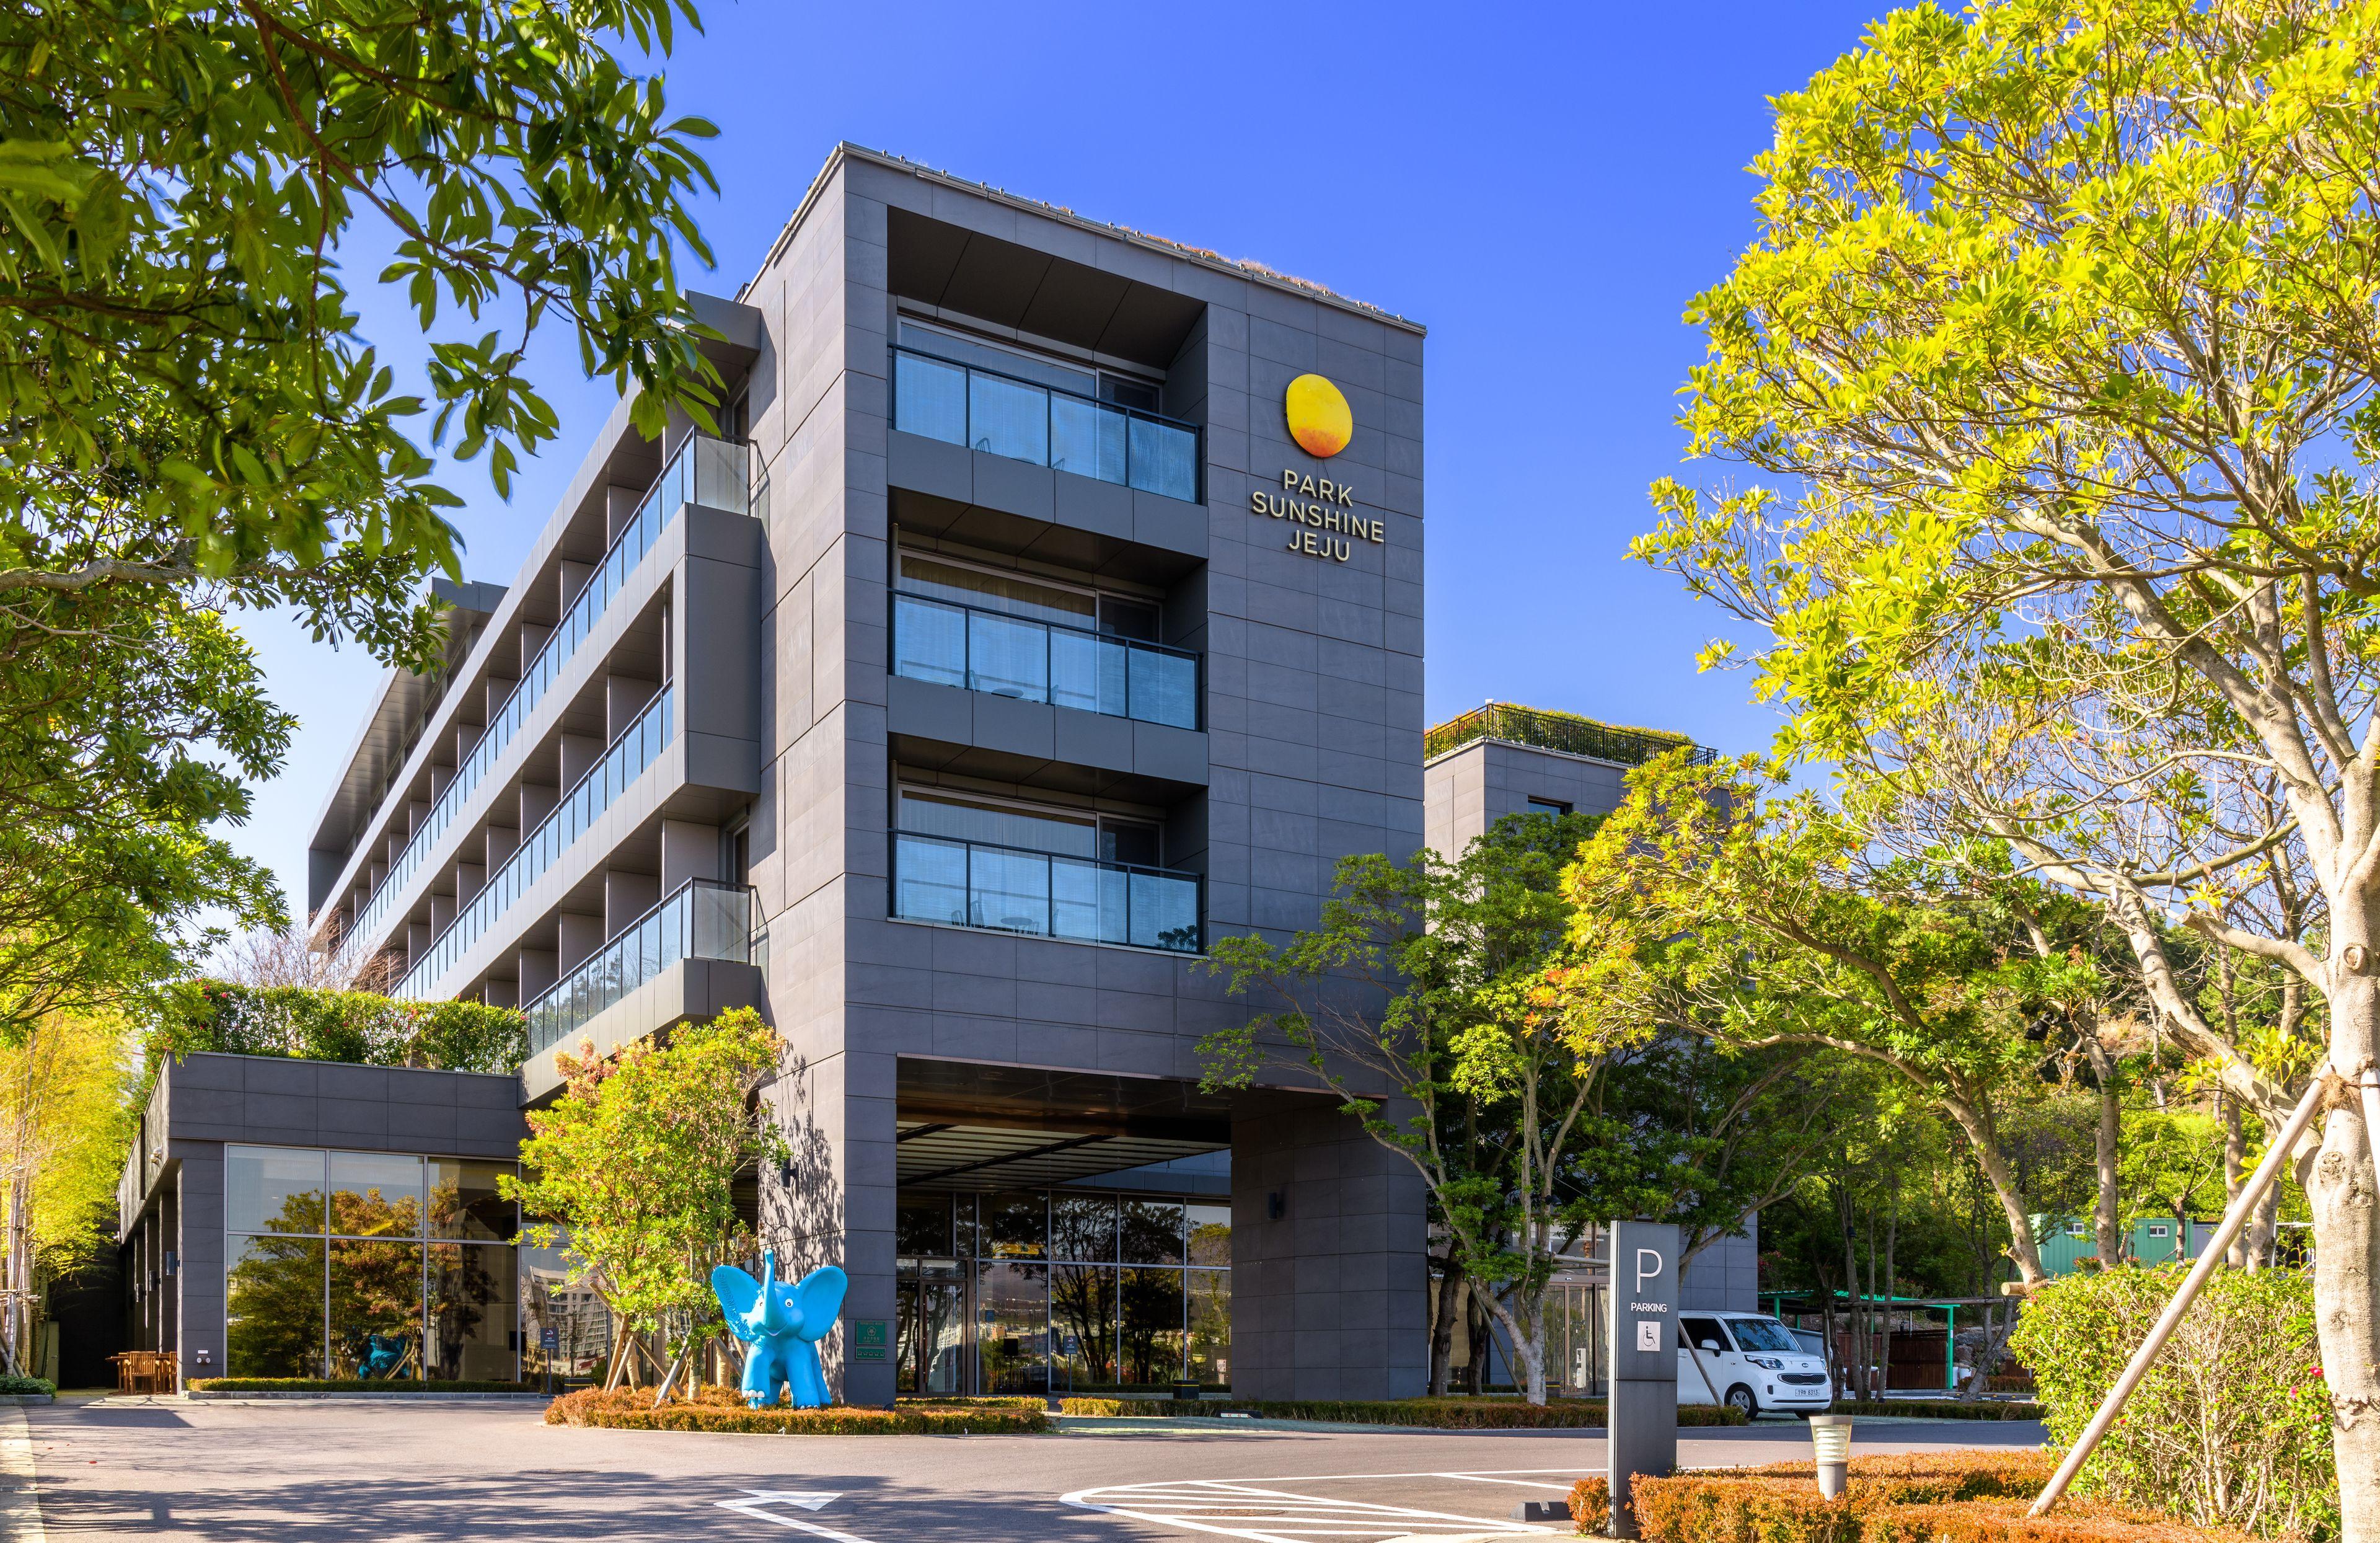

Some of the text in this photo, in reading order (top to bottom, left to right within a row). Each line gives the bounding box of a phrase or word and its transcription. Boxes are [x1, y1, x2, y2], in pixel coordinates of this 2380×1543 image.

[1284, 469, 1353, 507] PARK
[1252, 491, 1384, 542] SUNSHINE
[1288, 529, 1350, 561] JEJU
[1636, 1249, 1662, 1293] P
[1631, 1302, 1667, 1312] PARKING
